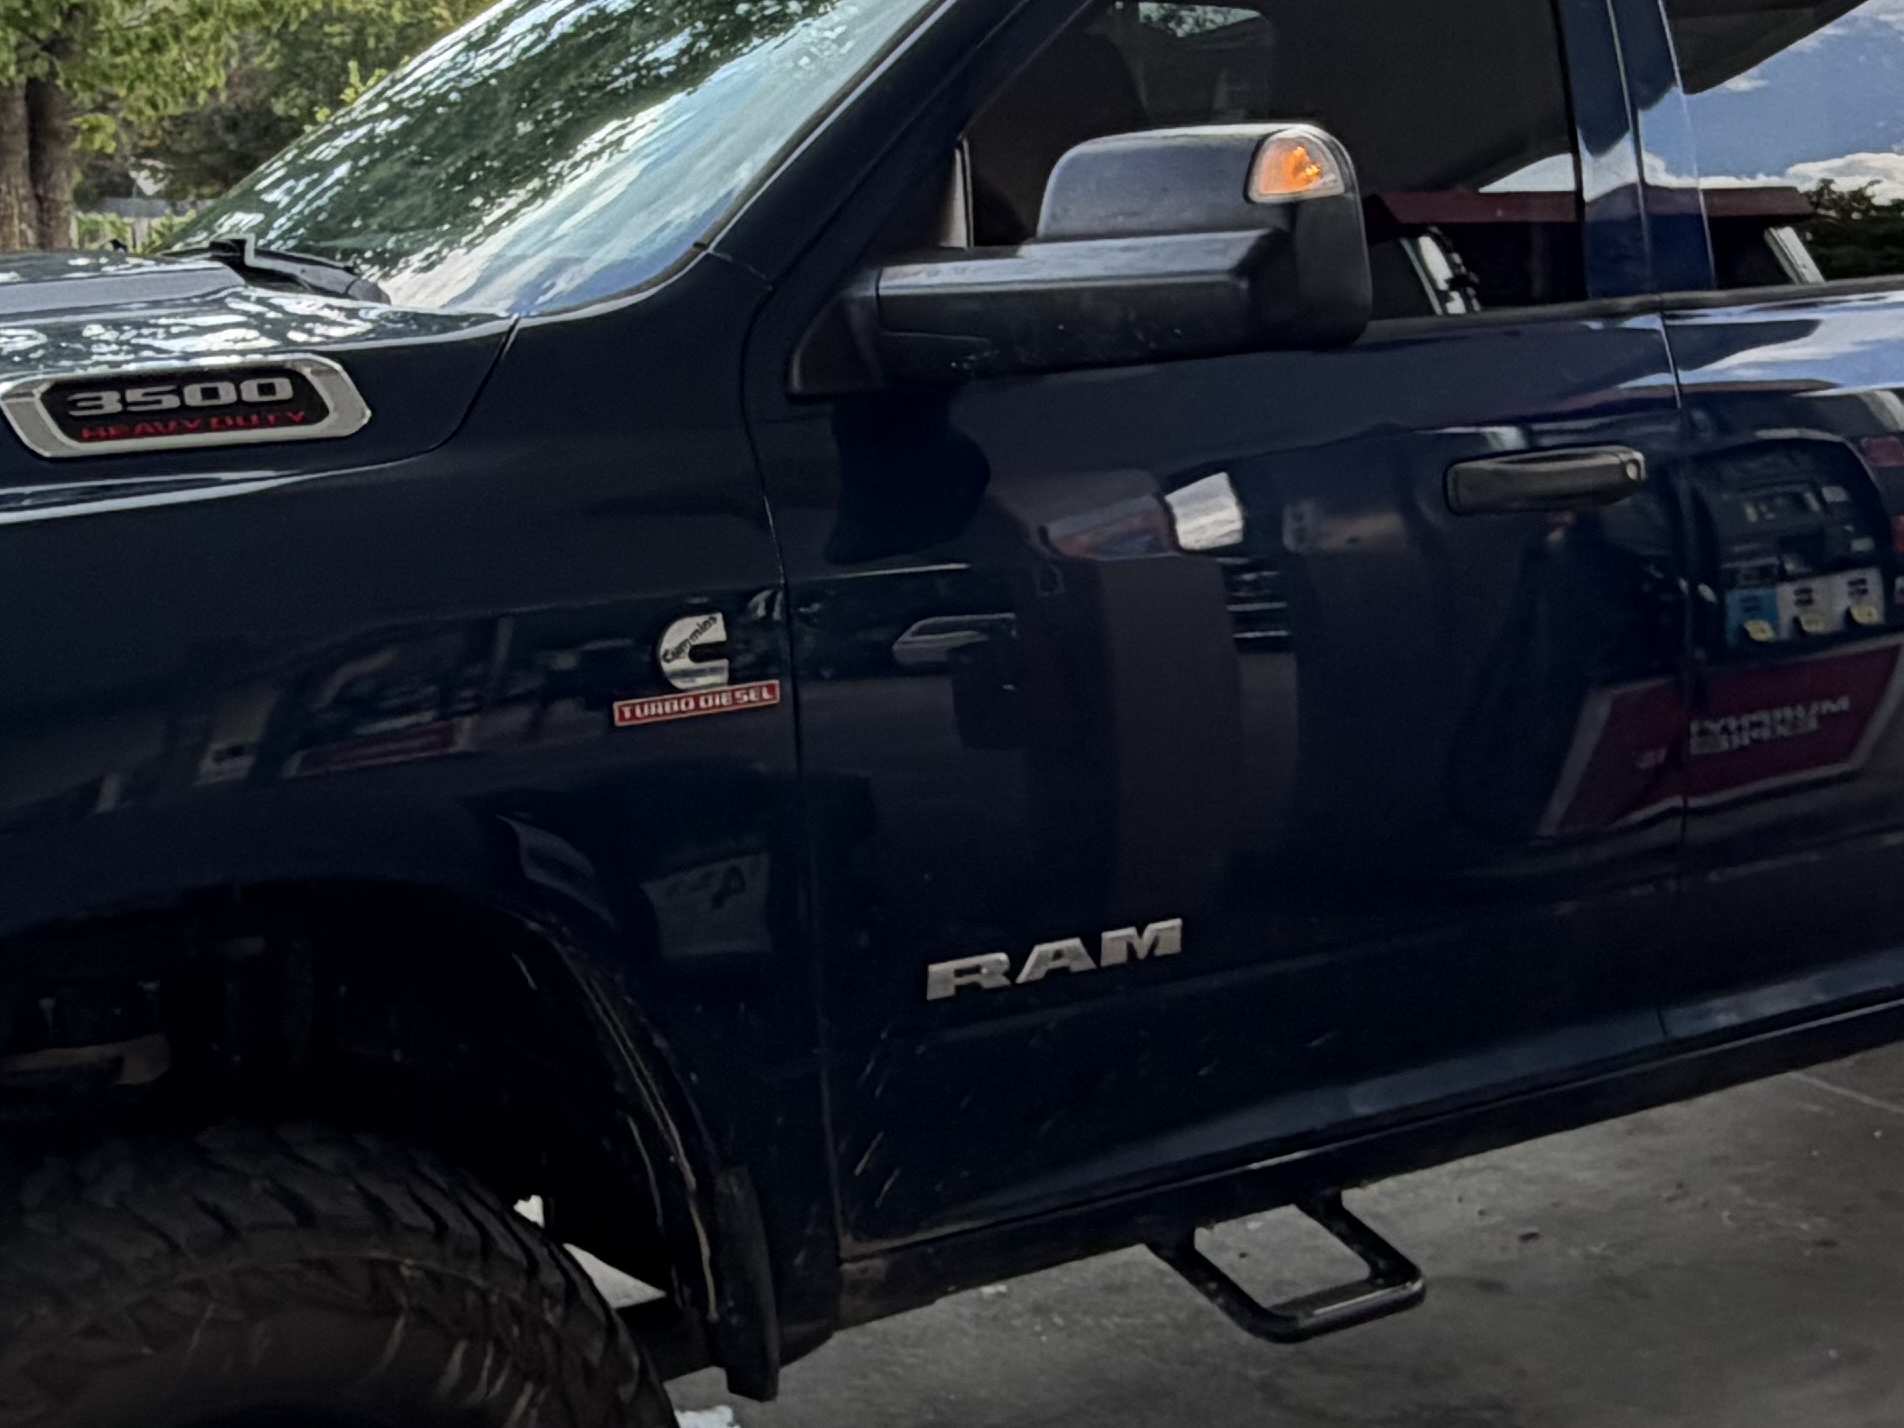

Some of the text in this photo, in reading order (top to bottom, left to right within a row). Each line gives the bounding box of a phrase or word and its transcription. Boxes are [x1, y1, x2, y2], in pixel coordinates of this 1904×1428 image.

[66, 376, 295, 417] 3500
[80, 410, 307, 441] HEAVY DUTY
[661, 615, 718, 664] Cummins
[620, 685, 774, 721] TURBO DIESEL
[926, 917, 1183, 1001] RAM
